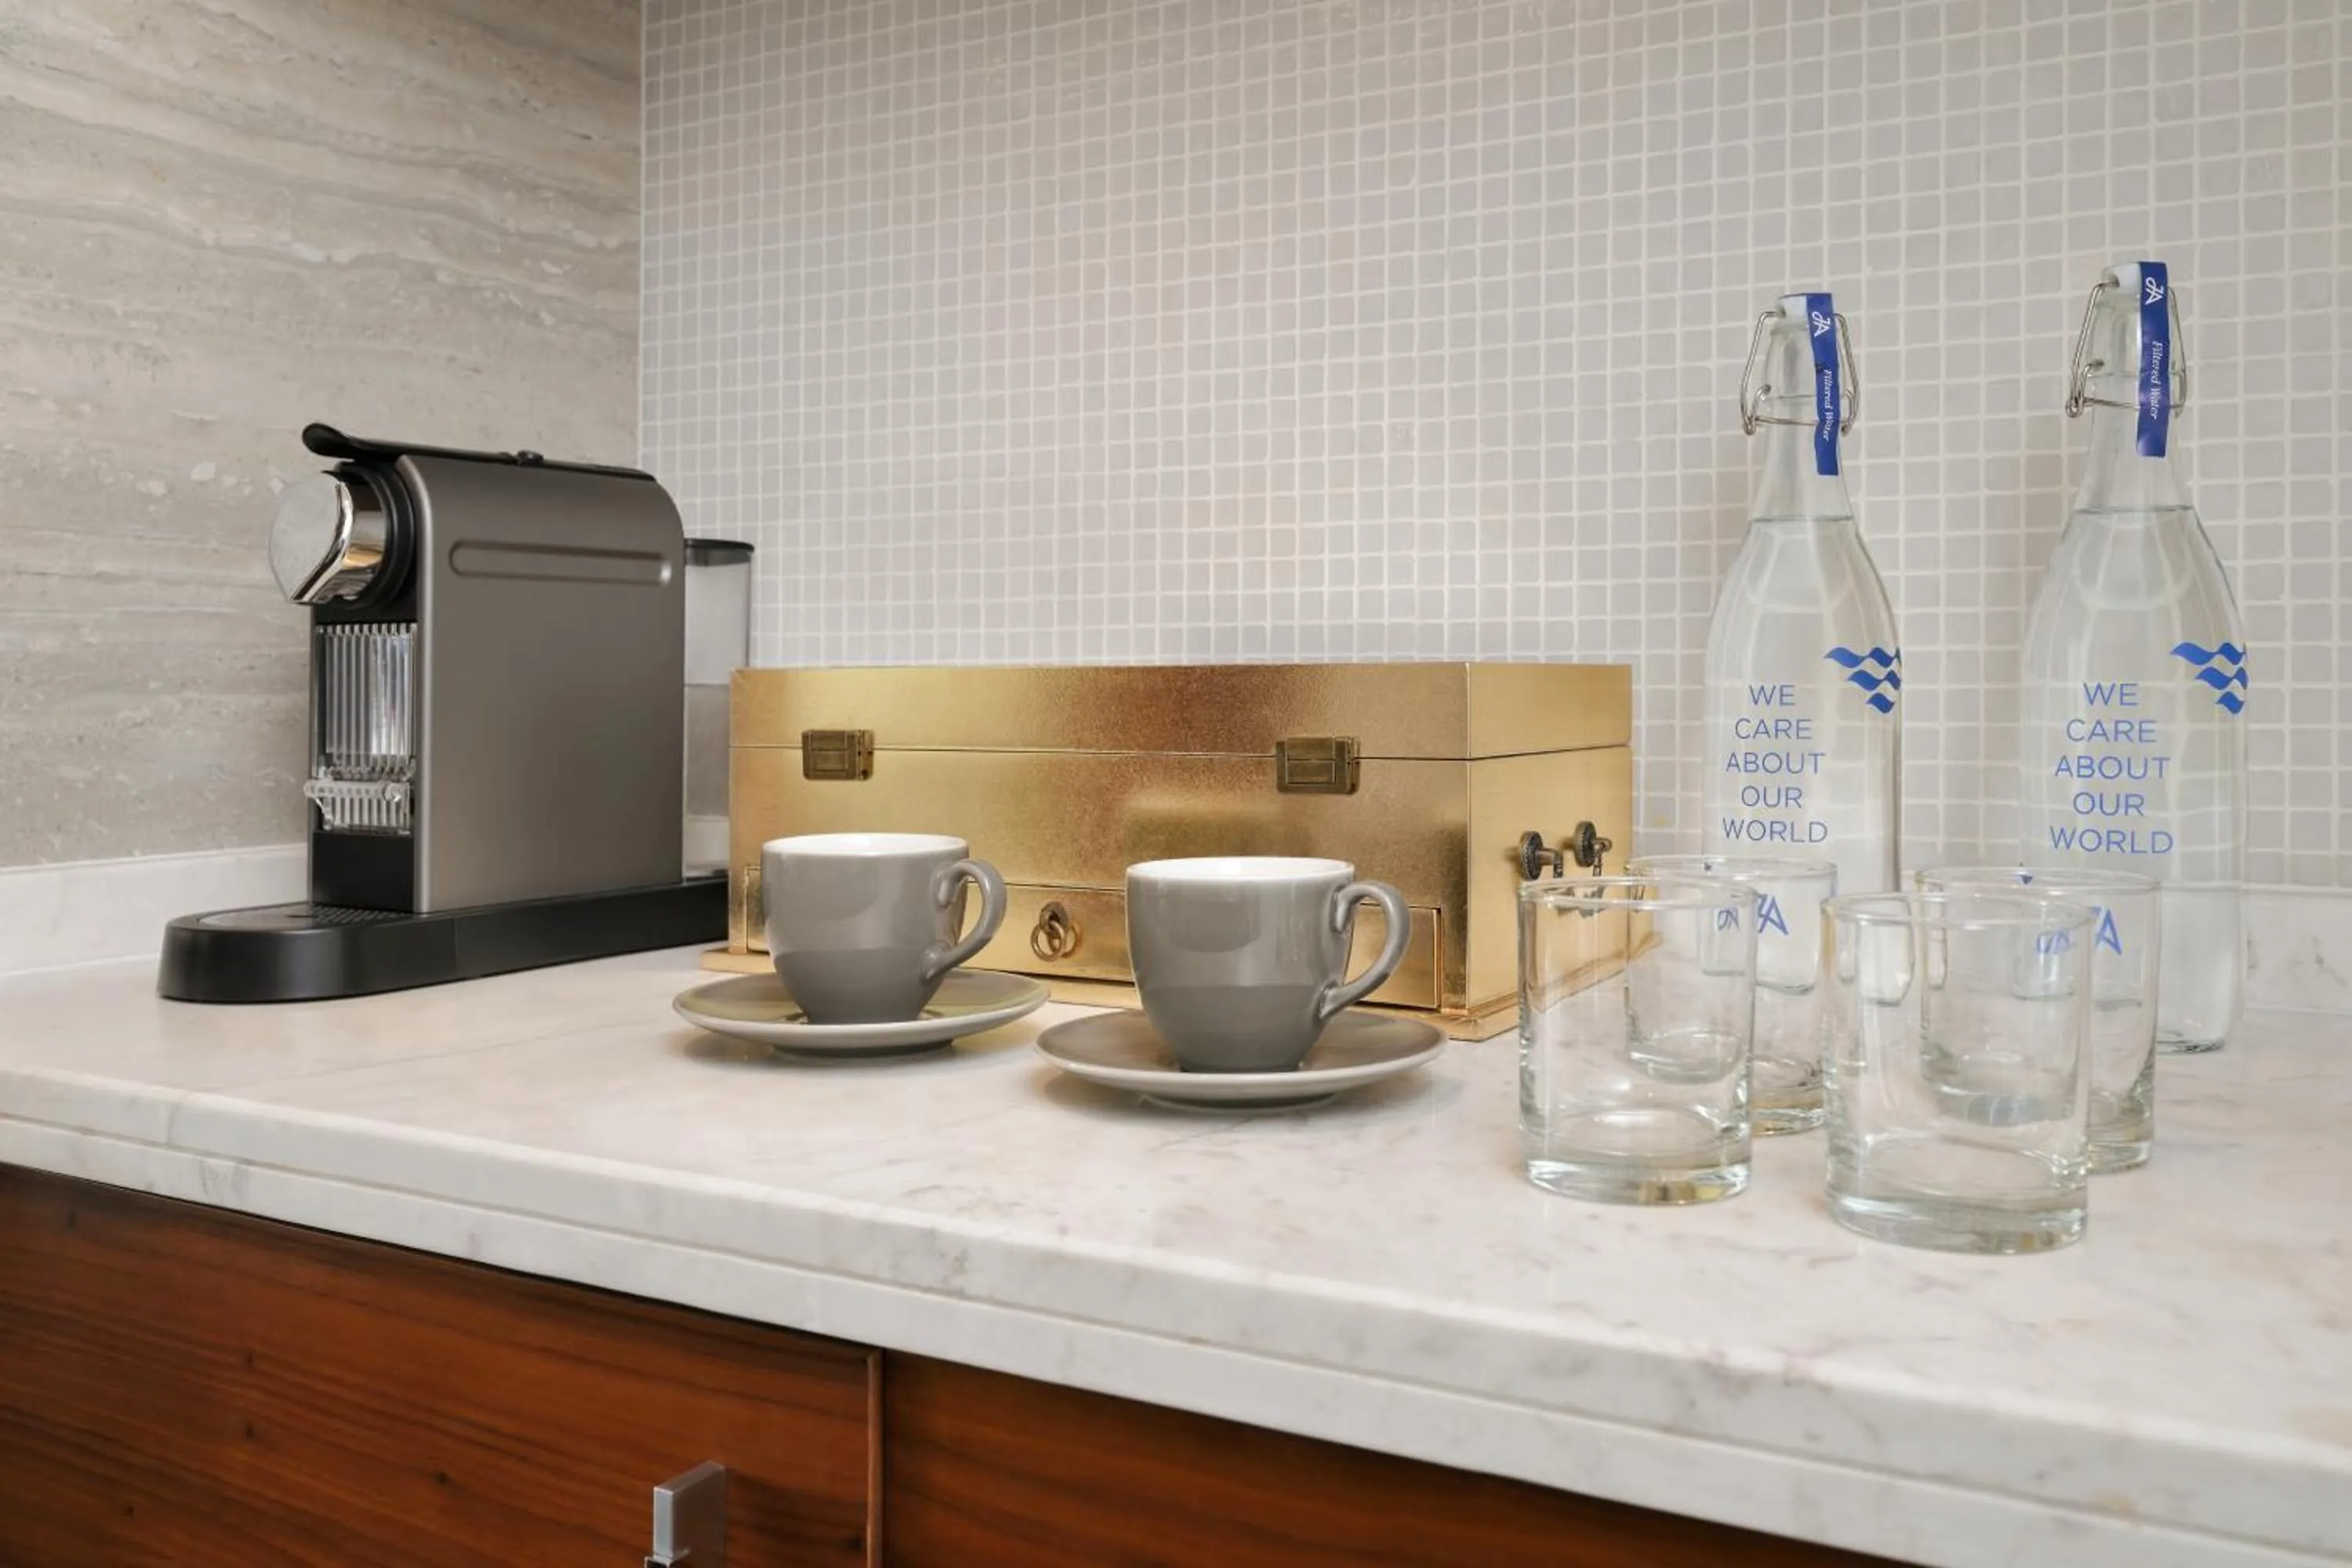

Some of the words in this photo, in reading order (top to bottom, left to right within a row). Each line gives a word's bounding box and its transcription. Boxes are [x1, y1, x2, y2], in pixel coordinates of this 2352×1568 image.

[2151, 341, 2163, 385] Filtered
[1824, 369, 1833, 409] Filtered
[2151, 388, 2161, 420] Water
[1822, 412, 1834, 442] Water
[1749, 684, 1795, 706] WE
[2083, 682, 2138, 706] WE
[1735, 717, 1812, 739] CARE
[2067, 718, 2158, 742] CARE
[1726, 752, 1825, 774] ABOUT
[2055, 755, 2170, 779] ABOUT
[1741, 786, 1802, 808] OUR
[2073, 792, 2145, 816] OUR
[1723, 818, 1828, 843] WORLD
[2049, 826, 2173, 854] WORLD
